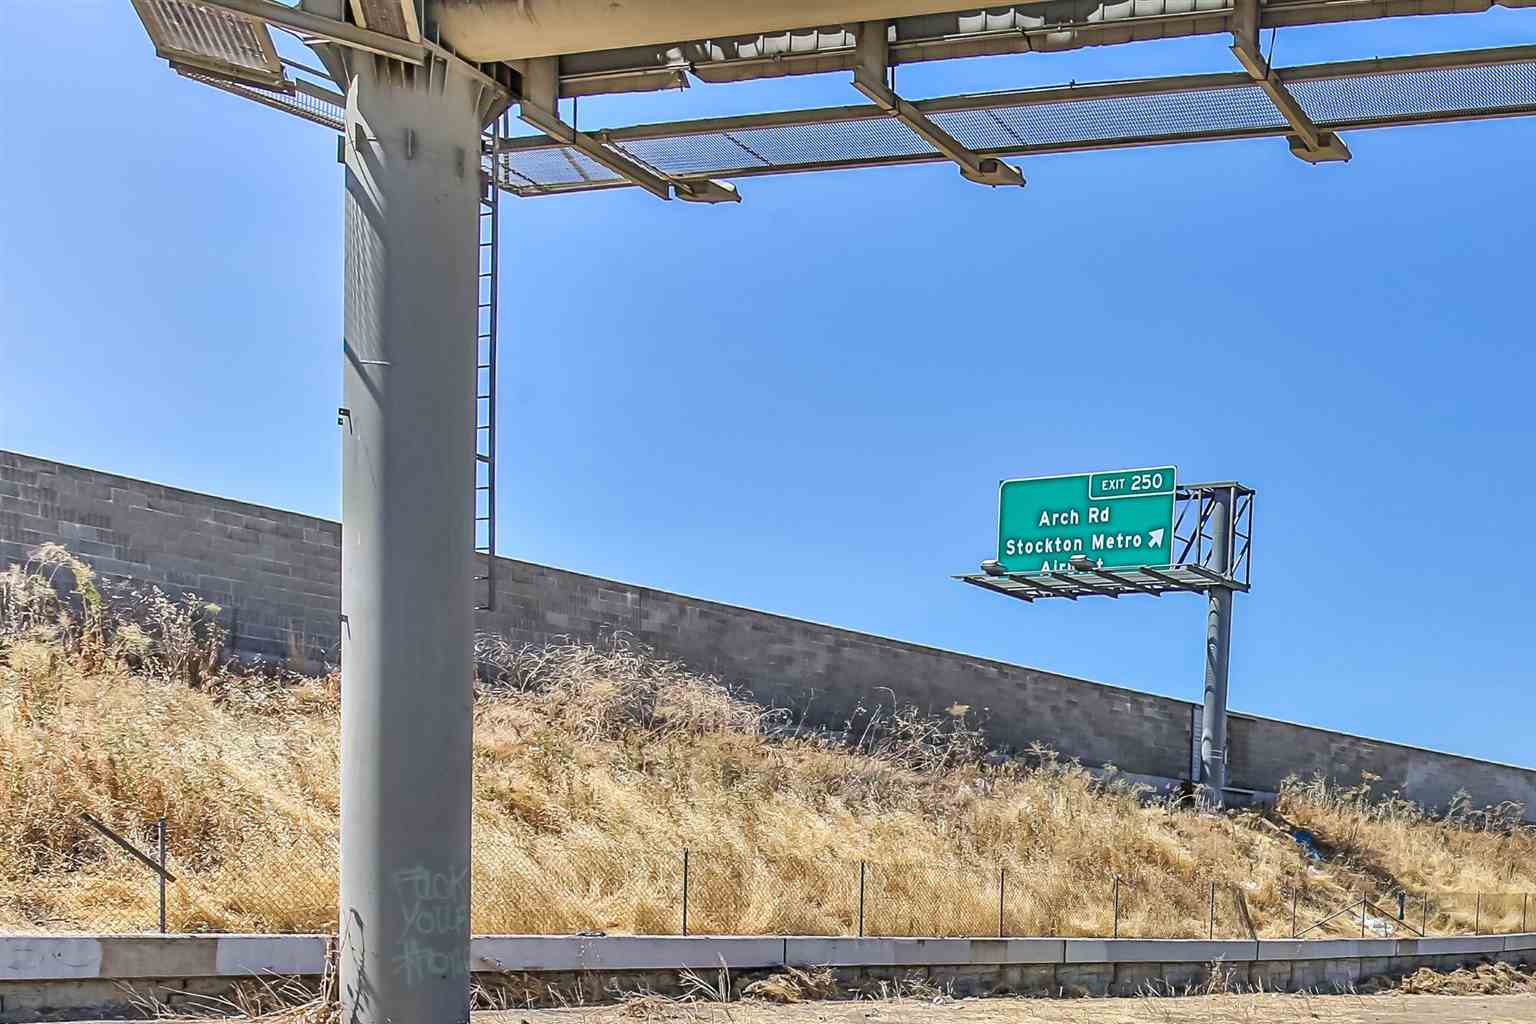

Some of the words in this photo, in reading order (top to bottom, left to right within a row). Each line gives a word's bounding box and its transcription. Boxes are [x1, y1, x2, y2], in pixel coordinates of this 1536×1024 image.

[1102, 479, 1125, 490] EXIT
[1131, 473, 1163, 490] 250
[1039, 509, 1079, 526] Arch
[1088, 507, 1109, 523] Rd
[1006, 537, 1082, 555] Stockton
[1092, 533, 1141, 550] Metro
[1041, 557, 1103, 572] Airt
